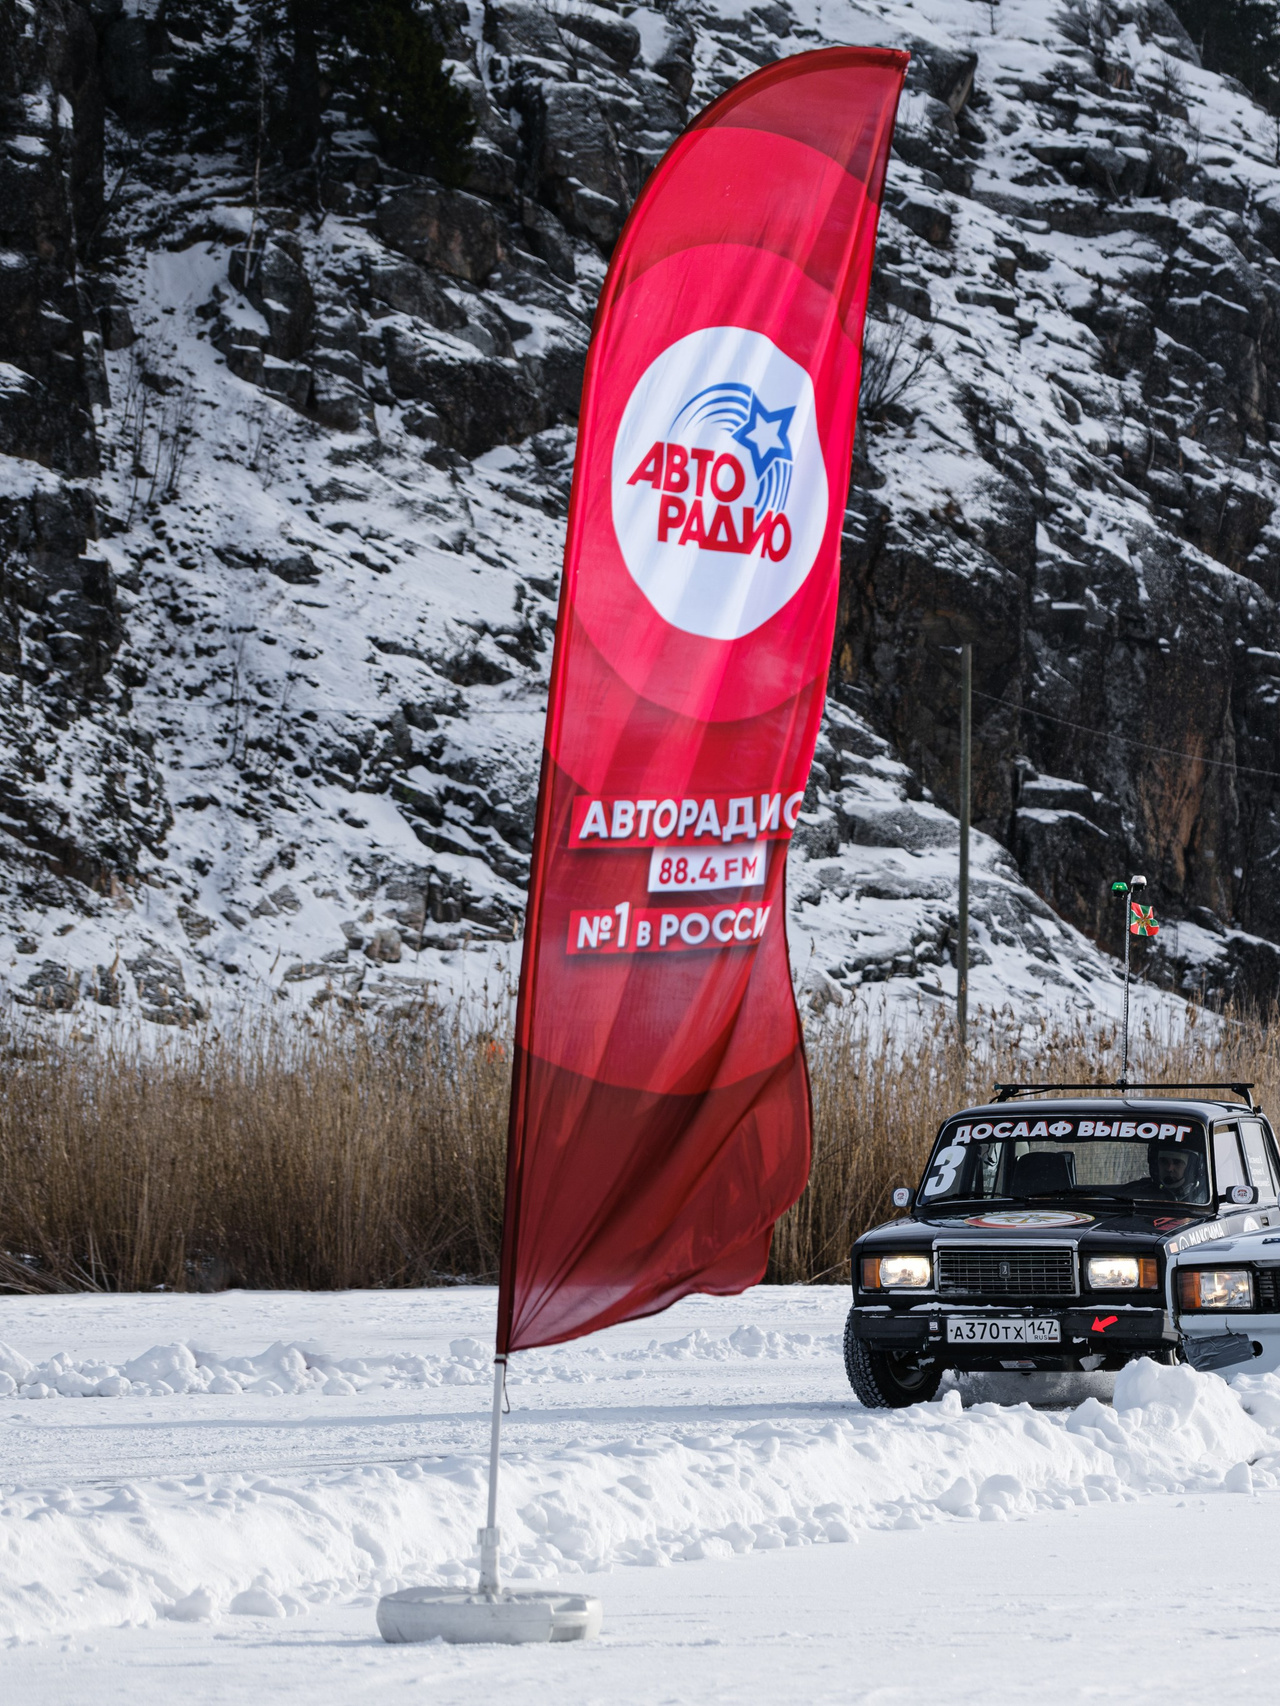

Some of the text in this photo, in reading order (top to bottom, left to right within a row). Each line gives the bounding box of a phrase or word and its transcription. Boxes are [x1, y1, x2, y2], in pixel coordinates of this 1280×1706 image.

[626, 441, 745, 502] АВТО
[657, 494, 792, 562] РАДИО
[659, 856, 758, 885] 88.4 FM
[577, 902, 630, 949] №1
[951, 1120, 1193, 1146] ДОСААФ ВЫБОРГ
[924, 1145, 966, 1197] 3
[954, 1321, 1054, 1340] А370ТХ 147
